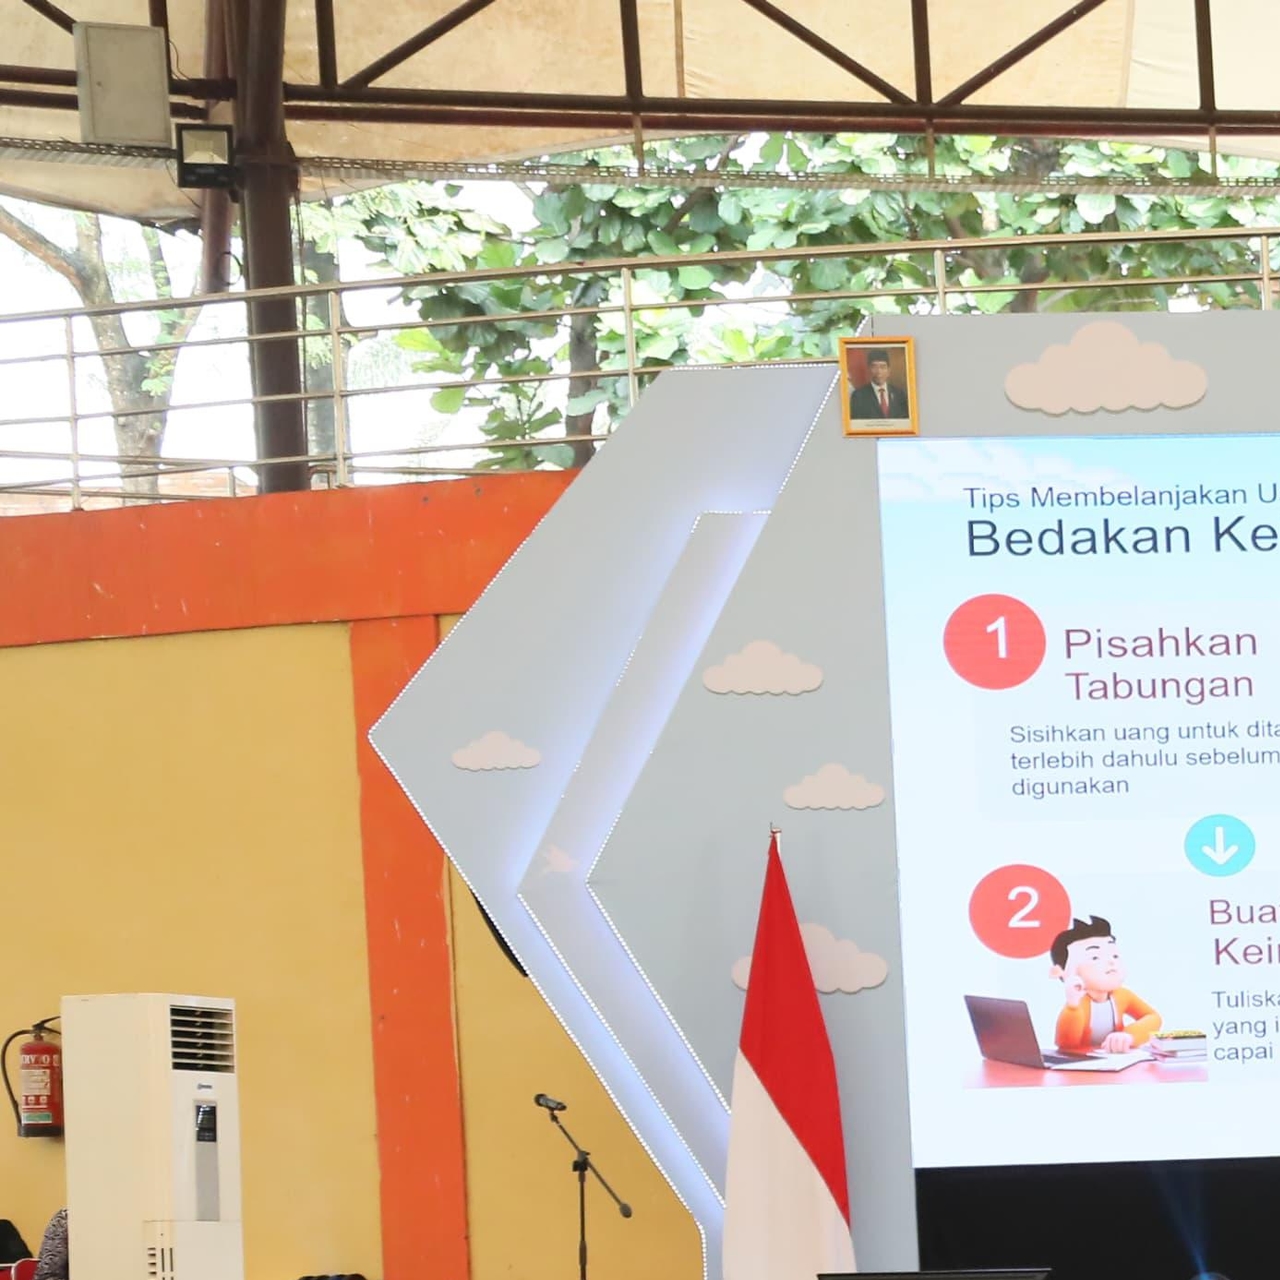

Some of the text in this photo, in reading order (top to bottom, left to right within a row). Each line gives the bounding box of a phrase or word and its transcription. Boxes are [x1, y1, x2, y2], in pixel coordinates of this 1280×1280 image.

[963, 487, 1021, 514] Tips
[1031, 483, 1247, 511] Membelanjakan
[967, 517, 1190, 557] Bedakan
[986, 615, 1007, 659] 1
[1065, 626, 1257, 660] Pisahkan
[1064, 671, 1253, 706] Tabungan
[1010, 725, 1106, 744] Sisihkan
[1114, 726, 1170, 745] uang
[1178, 721, 1239, 740] untuk
[1010, 747, 1280, 770] terlebih dahulu sebelum
[1011, 776, 1129, 800] digunakan
[1007, 885, 1041, 928] 2
[1212, 1020, 1267, 1040] yang
[1213, 1042, 1274, 1065] capai
